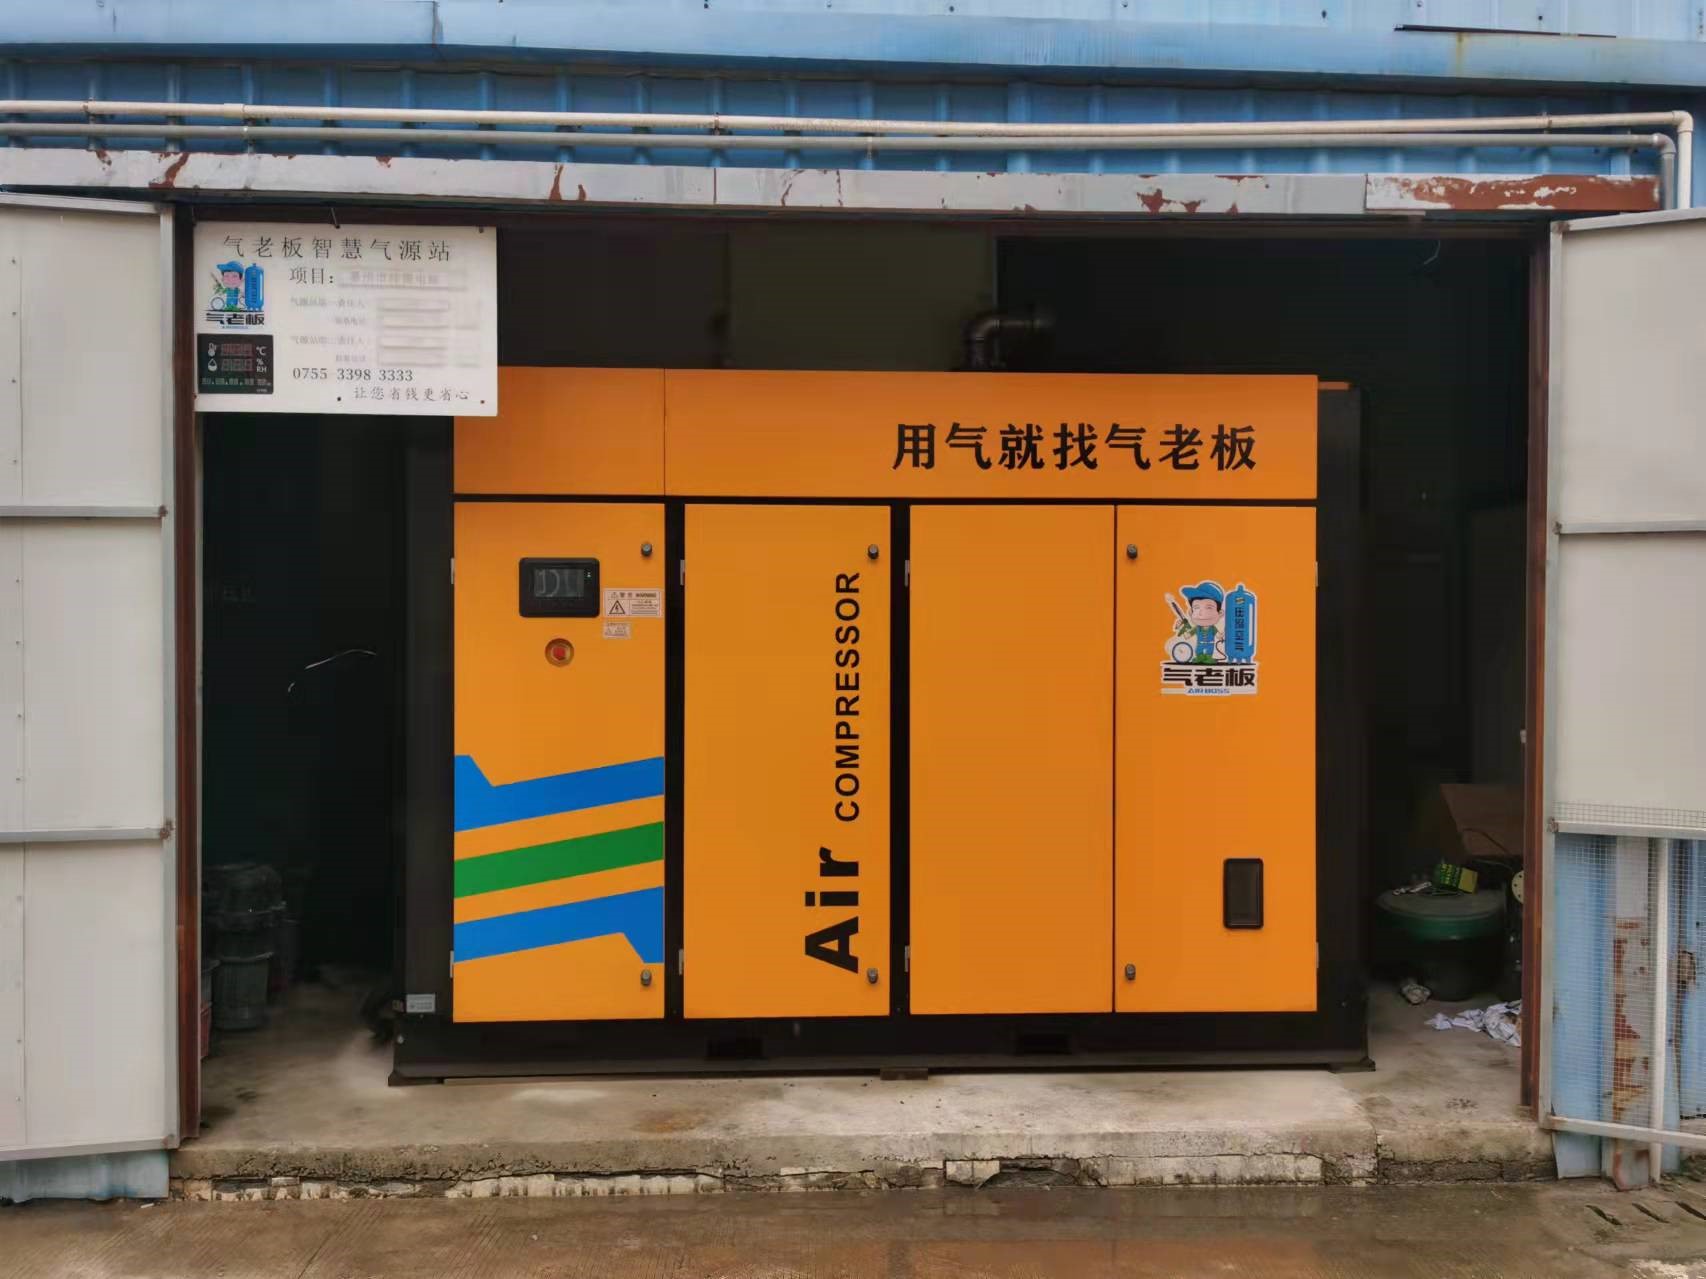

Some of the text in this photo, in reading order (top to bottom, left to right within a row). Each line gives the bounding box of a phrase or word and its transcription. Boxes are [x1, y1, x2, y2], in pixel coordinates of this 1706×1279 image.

[223, 235, 450, 262] 气老板智慧气源站
[206, 313, 265, 326] 气老板
[292, 367, 414, 382] 0755 3398 3333
[892, 422, 1257, 471] 用气就找气老板
[1163, 667, 1255, 687] 气老板
[804, 572, 860, 974] Air COMPRESSOR
